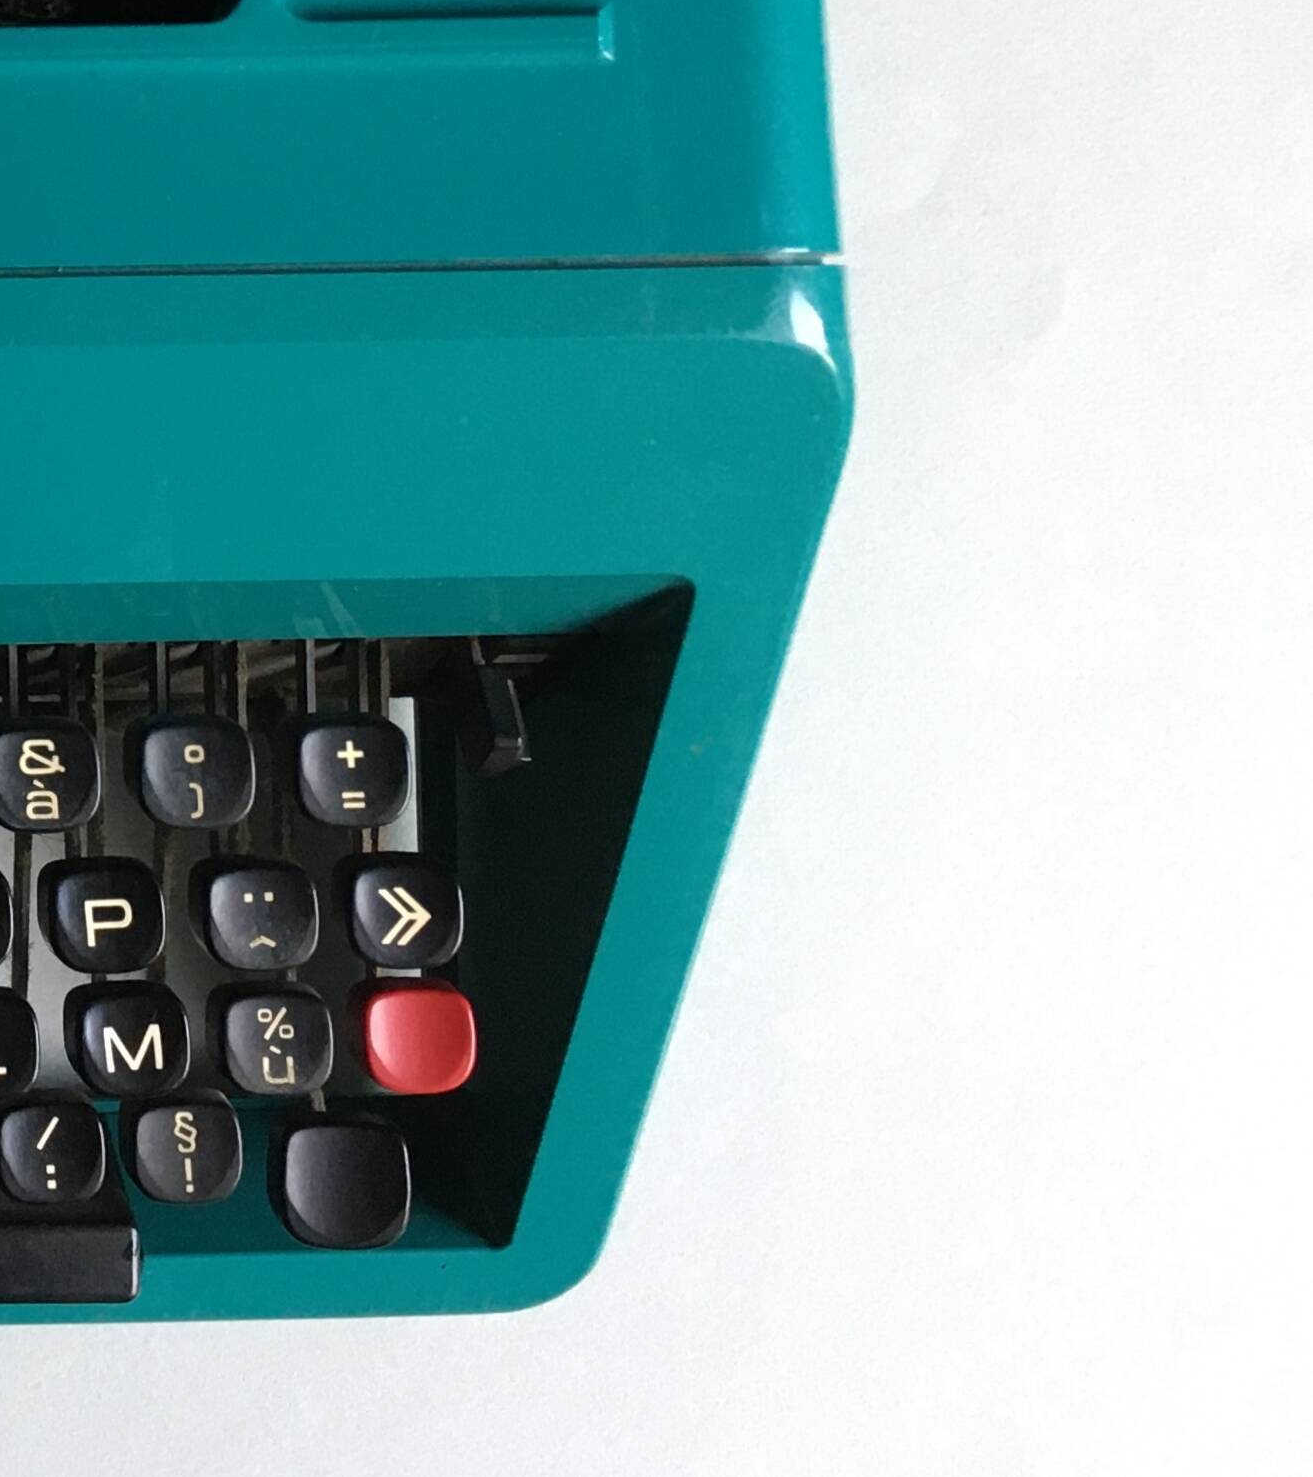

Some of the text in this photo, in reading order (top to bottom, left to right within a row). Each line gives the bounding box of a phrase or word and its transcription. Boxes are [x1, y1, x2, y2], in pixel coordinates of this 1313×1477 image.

[19, 739, 66, 775] &
[336, 740, 364, 769] +
[25, 779, 59, 820] à
[341, 791, 366, 809] =
[84, 898, 133, 948] P
[102, 1023, 164, 1074] M
[257, 1006, 294, 1041] %
[36, 1116, 59, 1151] /
[45, 1164, 57, 1190] :
[184, 1158, 194, 1193] !
